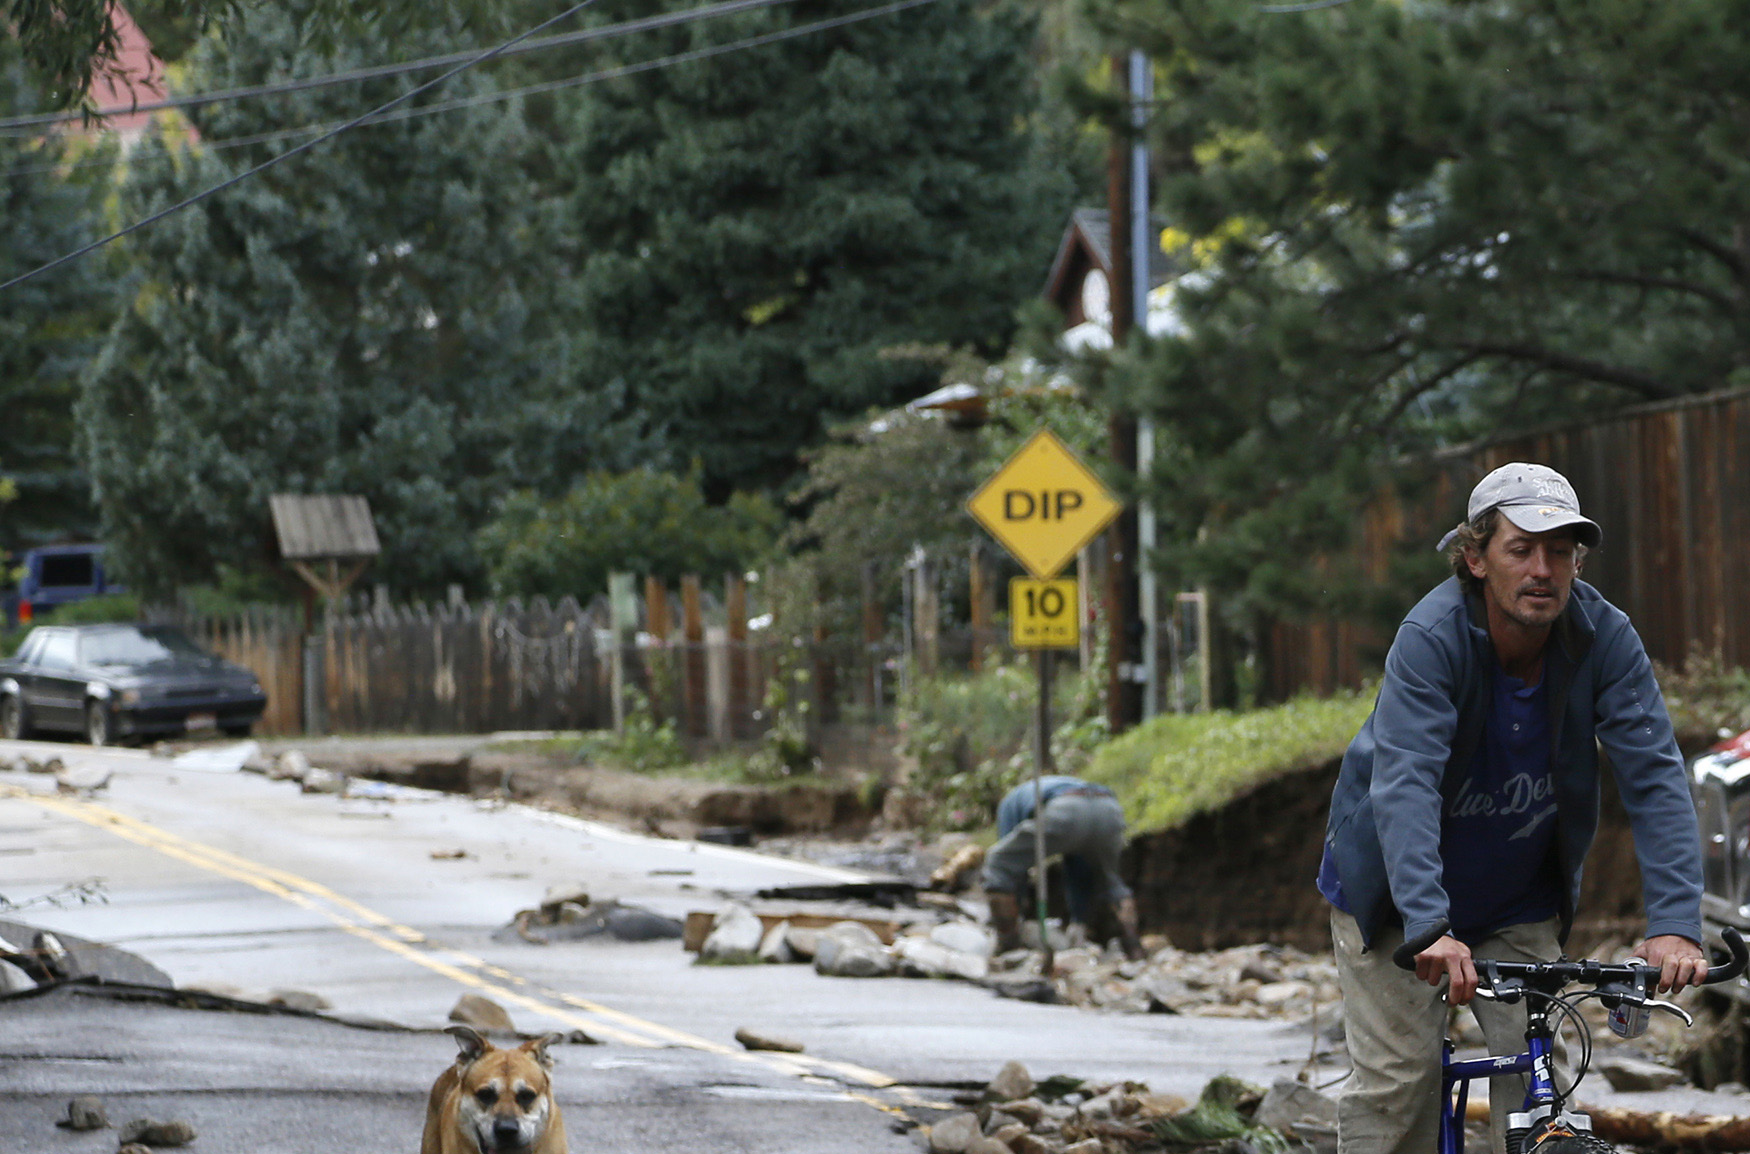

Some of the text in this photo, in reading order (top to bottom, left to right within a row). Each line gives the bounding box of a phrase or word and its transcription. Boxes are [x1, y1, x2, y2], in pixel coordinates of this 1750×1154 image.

[1004, 489, 1083, 521] DIP
[1026, 587, 1065, 618] 10
[1449, 776, 1497, 817] lue
